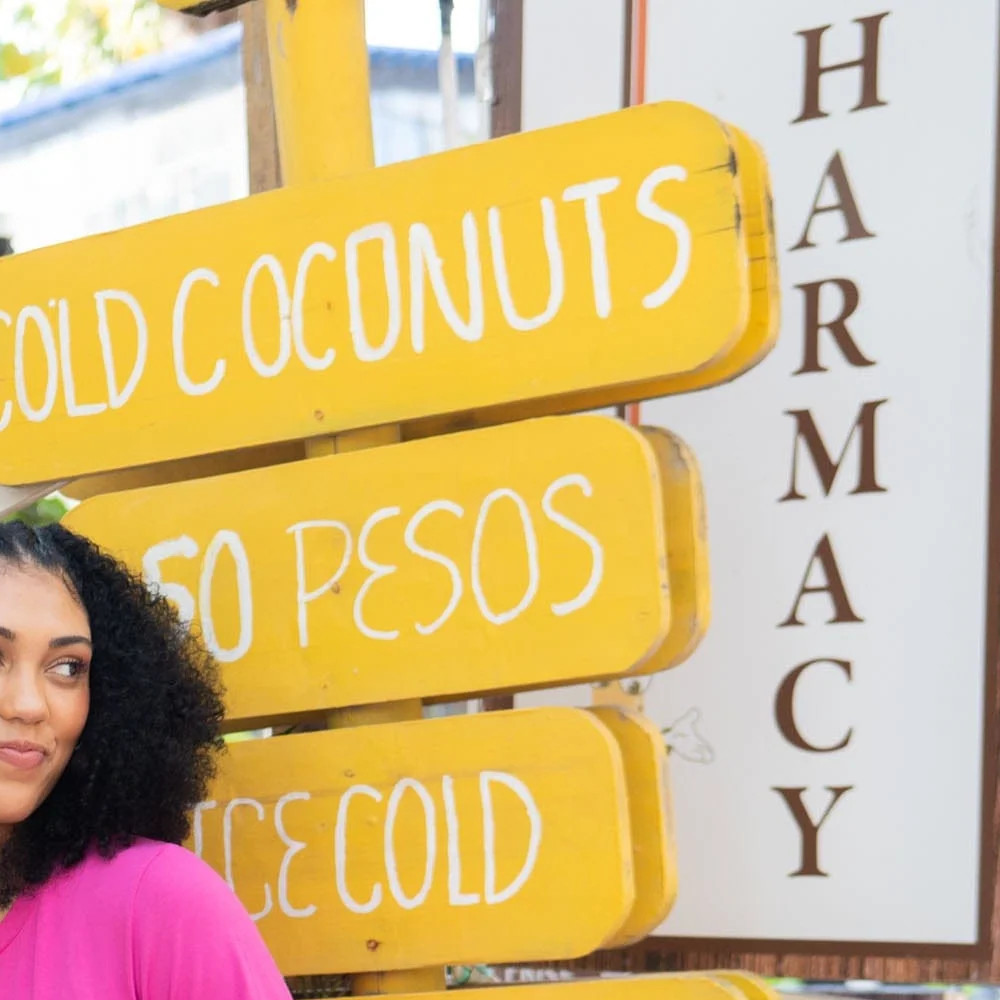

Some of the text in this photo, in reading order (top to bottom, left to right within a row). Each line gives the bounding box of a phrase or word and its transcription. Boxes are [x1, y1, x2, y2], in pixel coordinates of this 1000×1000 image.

[171, 164, 692, 397] COCONUTS
[285, 473, 604, 648] PESOS
[334, 771, 542, 914] COLD
